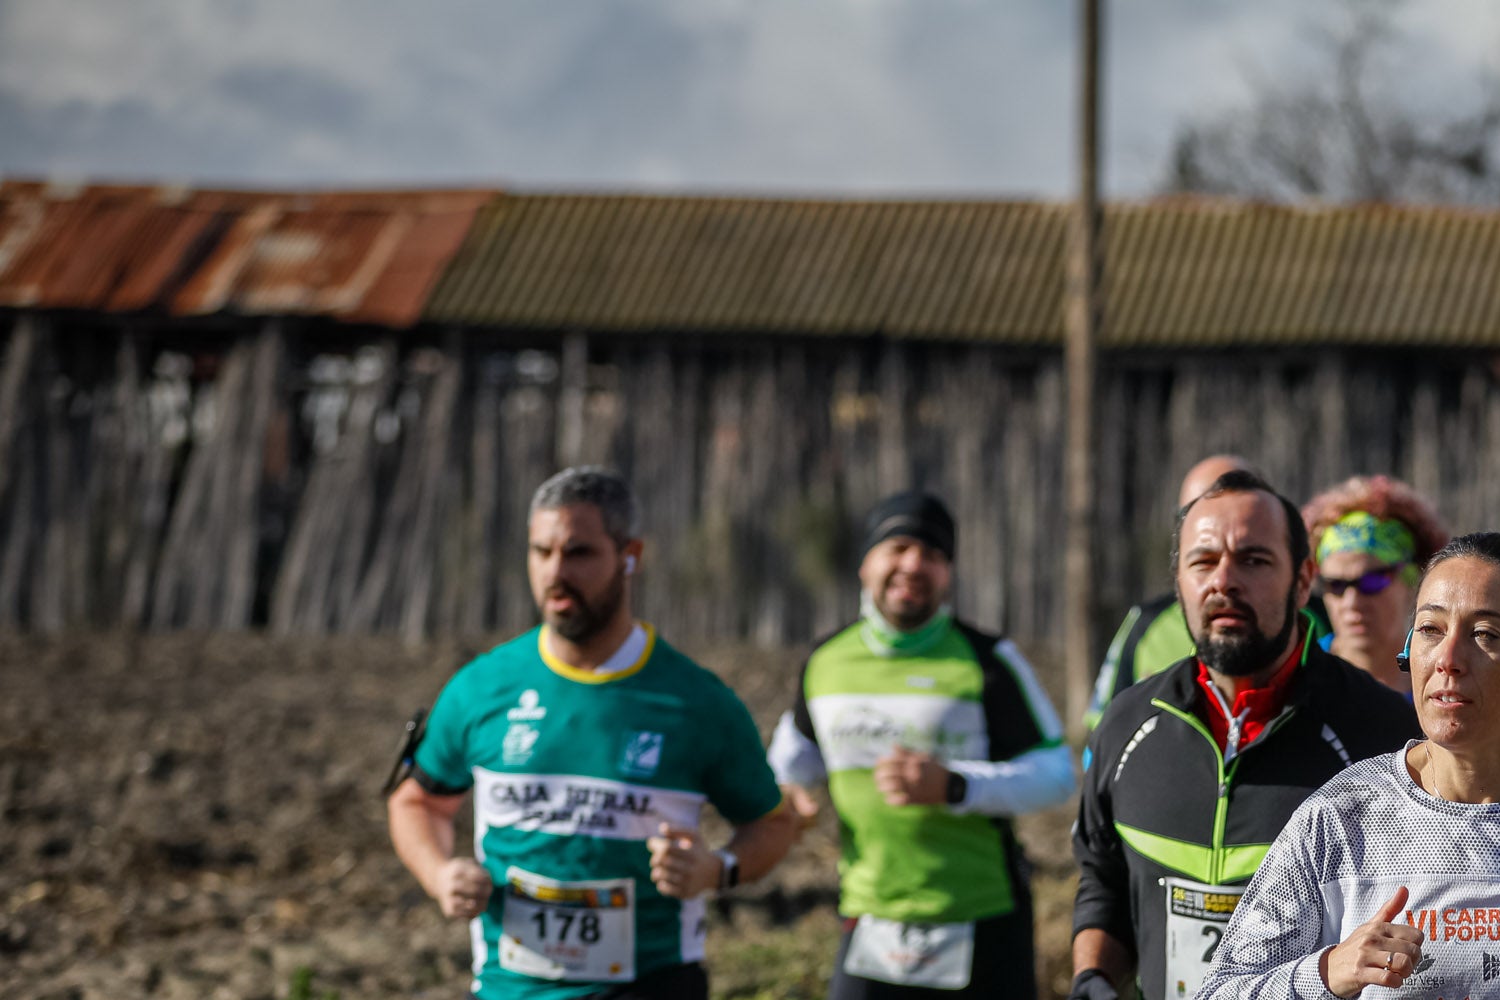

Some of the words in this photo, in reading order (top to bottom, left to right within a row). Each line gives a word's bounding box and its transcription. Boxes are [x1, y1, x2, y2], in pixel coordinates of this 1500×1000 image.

[490, 783, 550, 802] CAJA
[533, 908, 601, 944] 178
[1406, 909, 1437, 942] VI
[1418, 975, 1445, 988] Vega
